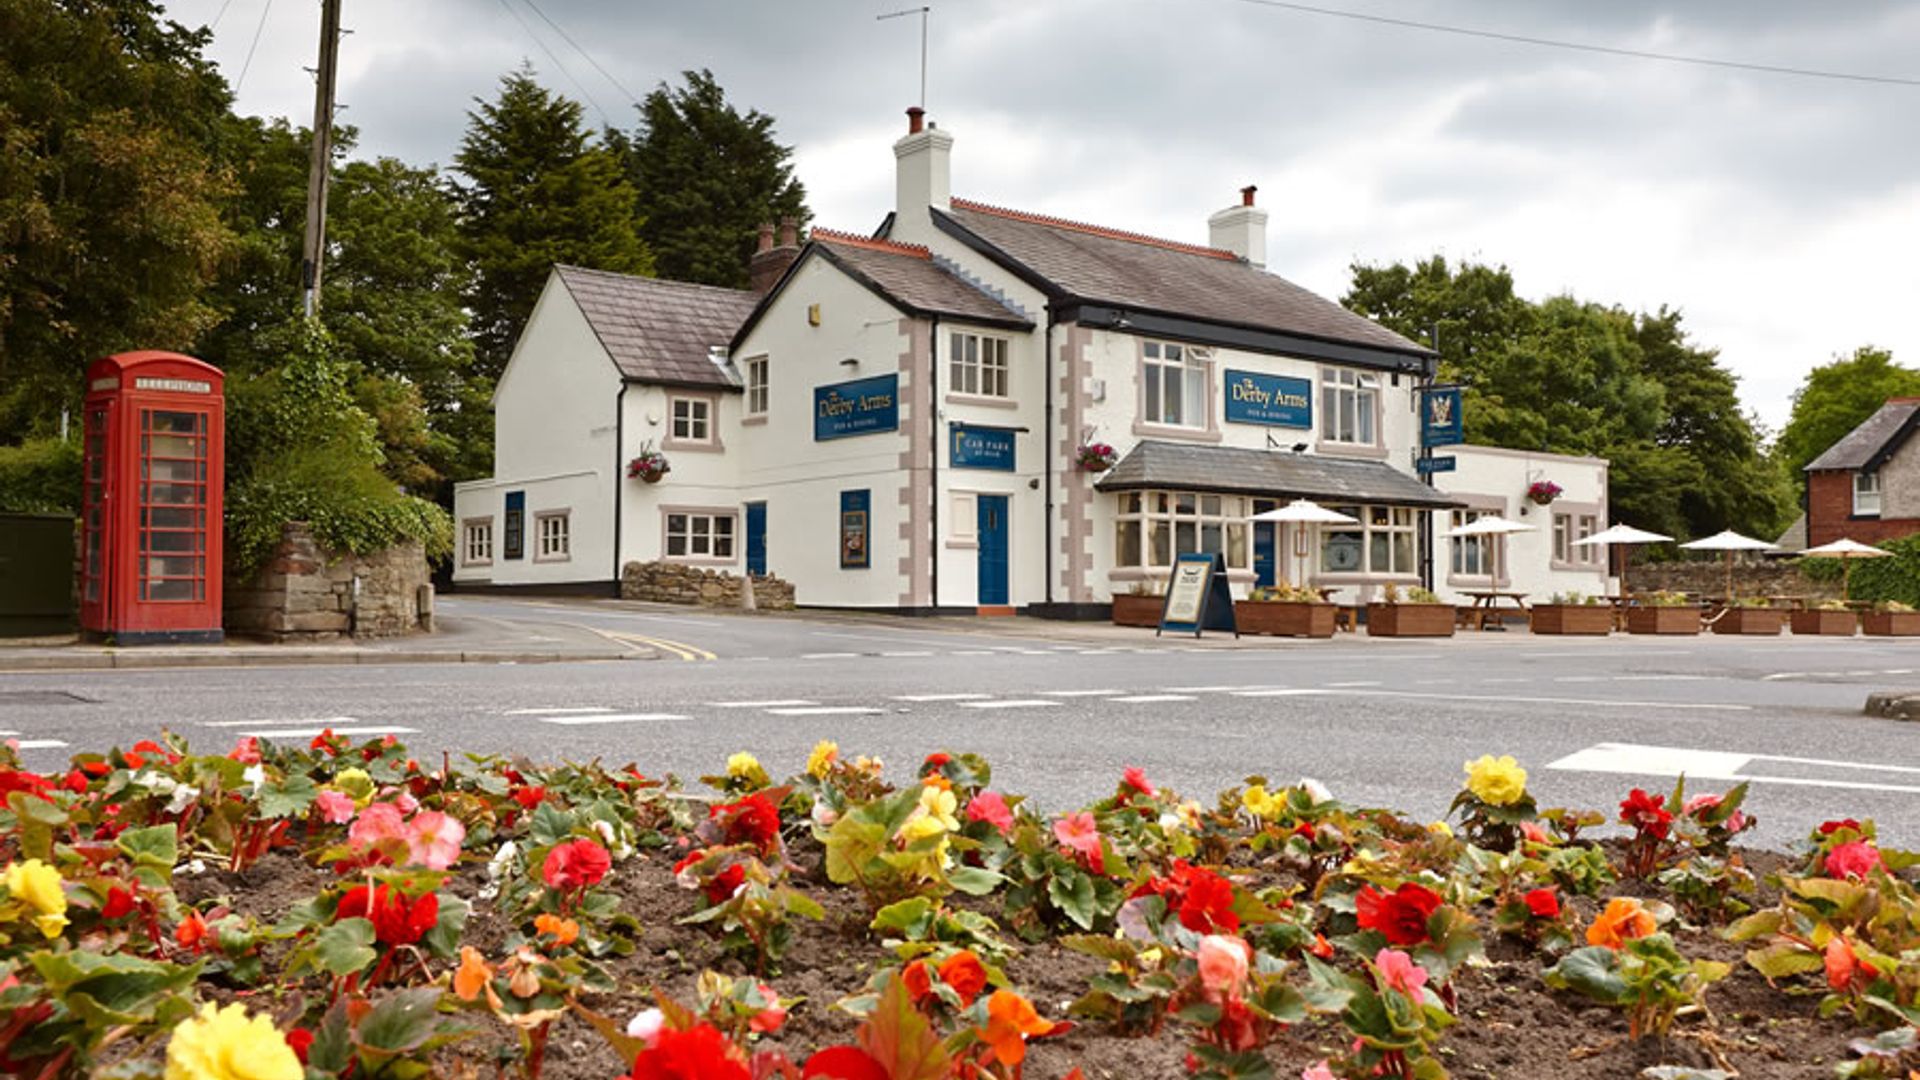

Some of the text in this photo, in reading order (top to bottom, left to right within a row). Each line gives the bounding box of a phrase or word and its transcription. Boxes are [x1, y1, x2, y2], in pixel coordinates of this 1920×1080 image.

[819, 395, 892, 419] Derby Arms
[1232, 384, 1308, 408] Derby Arms
